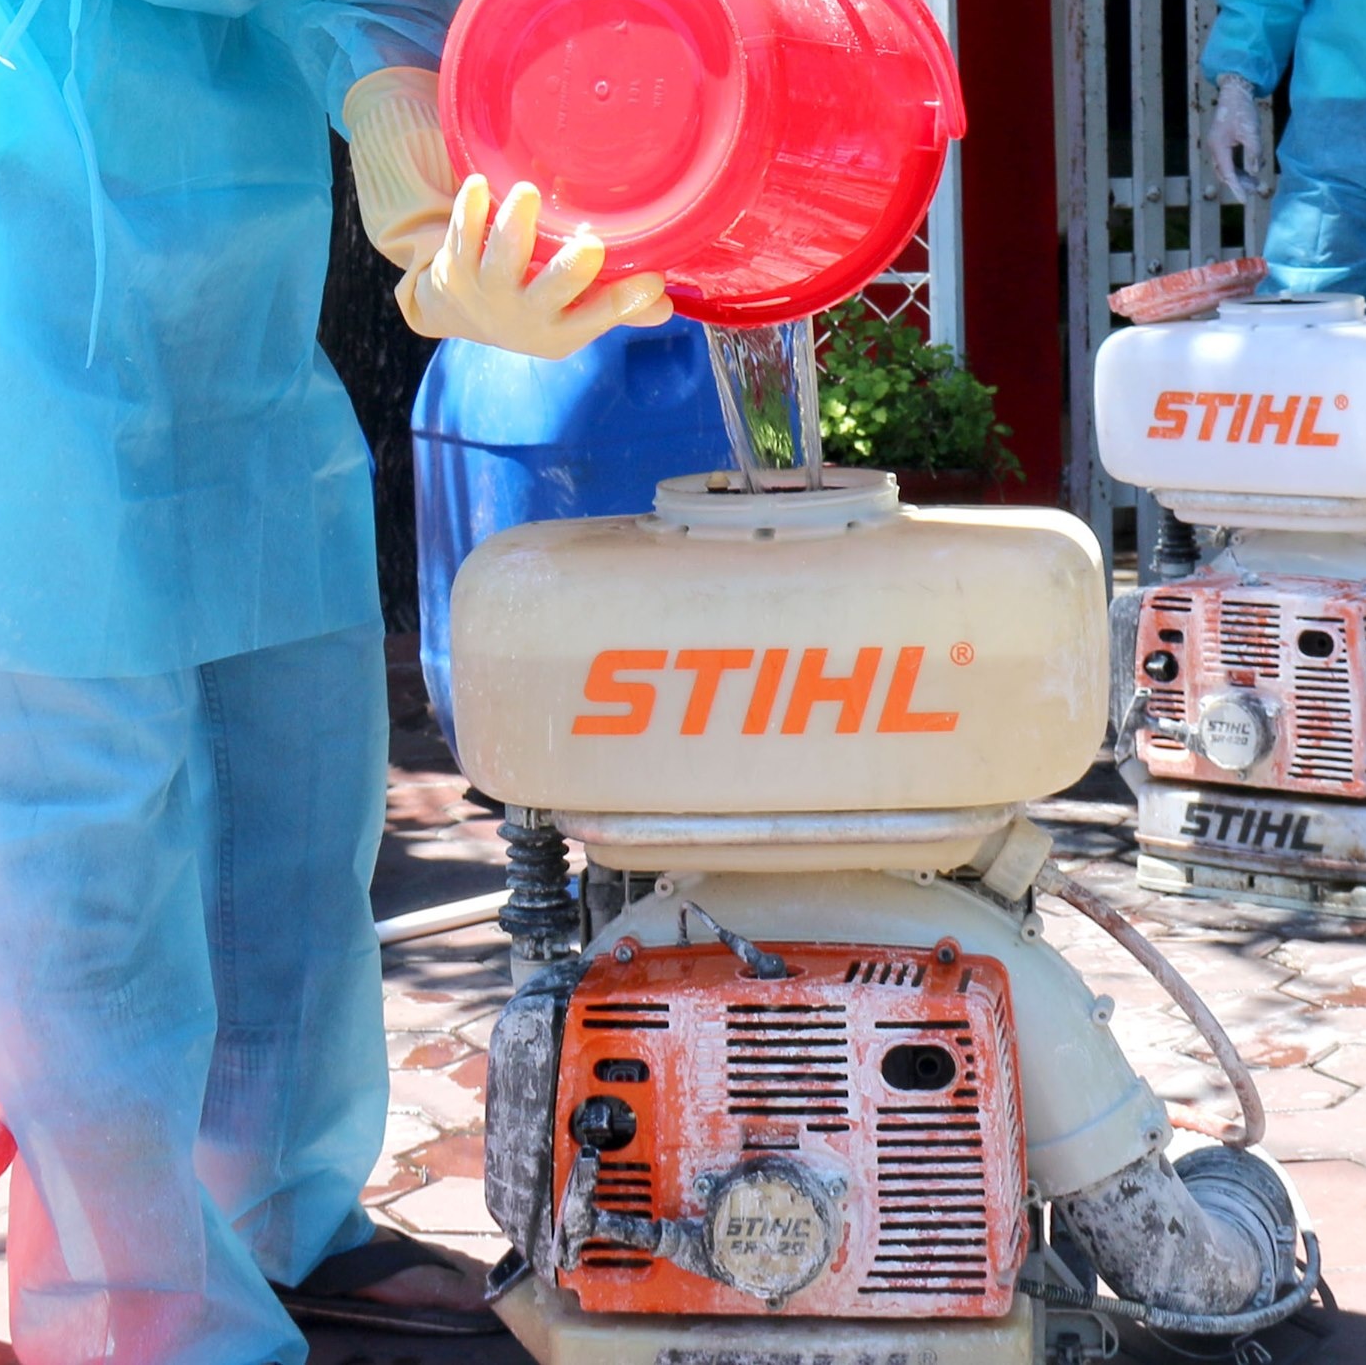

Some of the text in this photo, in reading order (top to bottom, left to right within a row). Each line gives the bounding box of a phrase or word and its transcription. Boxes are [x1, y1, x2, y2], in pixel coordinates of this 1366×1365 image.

[1147, 391, 1340, 447] STIHL
[571, 646, 960, 735] STIHL
[1207, 721, 1250, 734] STIHL
[1180, 802, 1324, 852] STIHL
